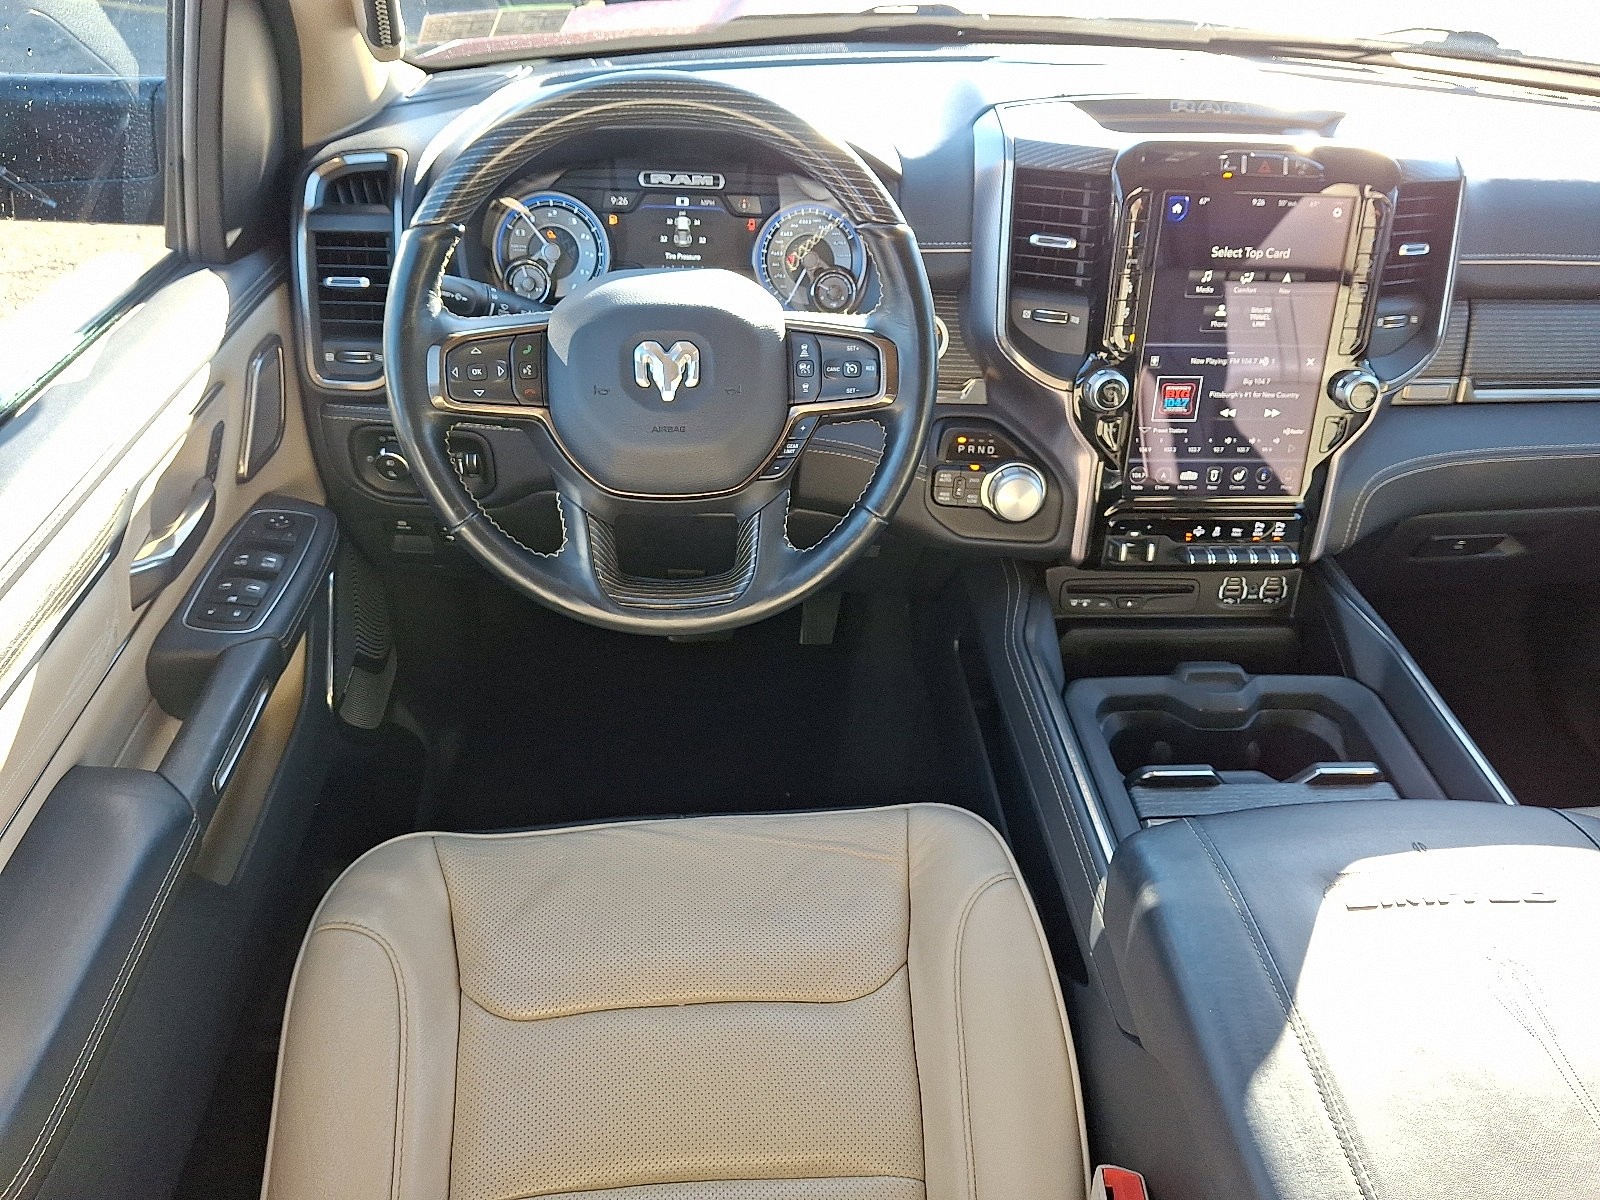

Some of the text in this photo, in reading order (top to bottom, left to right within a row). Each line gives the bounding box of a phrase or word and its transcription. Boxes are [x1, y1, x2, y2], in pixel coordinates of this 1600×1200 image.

[650, 173, 714, 186] RAM
[1211, 246, 1292, 260] Select Top Card
[471, 368, 483, 376] OK
[1165, 389, 1191, 398] BIG
[1276, 392, 1300, 401] Country
[651, 425, 686, 433] AIRBAG
